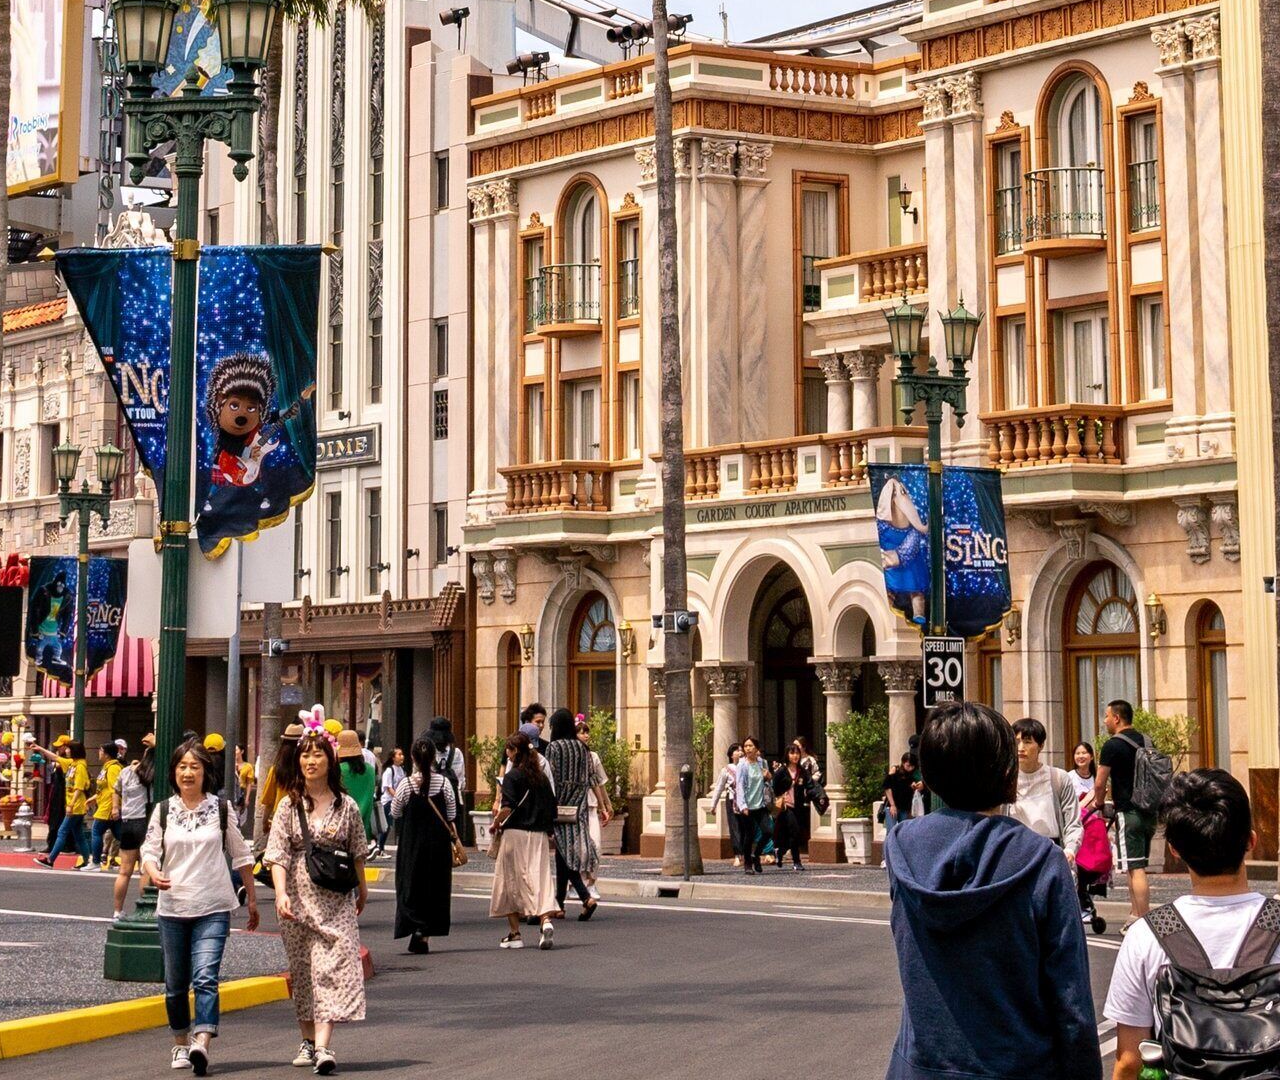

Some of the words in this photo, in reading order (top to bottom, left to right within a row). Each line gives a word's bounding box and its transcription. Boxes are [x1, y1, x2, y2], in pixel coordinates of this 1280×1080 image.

[134, 407, 157, 420] TOUR
[317, 436, 368, 459] DIME
[697, 505, 736, 523] GARDEN
[744, 503, 777, 519] COURT
[784, 496, 847, 516] APARTMENTS
[945, 532, 1008, 566] SING
[925, 641, 945, 652] SPEED
[945, 641, 963, 652] LIMIT
[927, 657, 962, 687] 30
[935, 690, 955, 702] MILES
